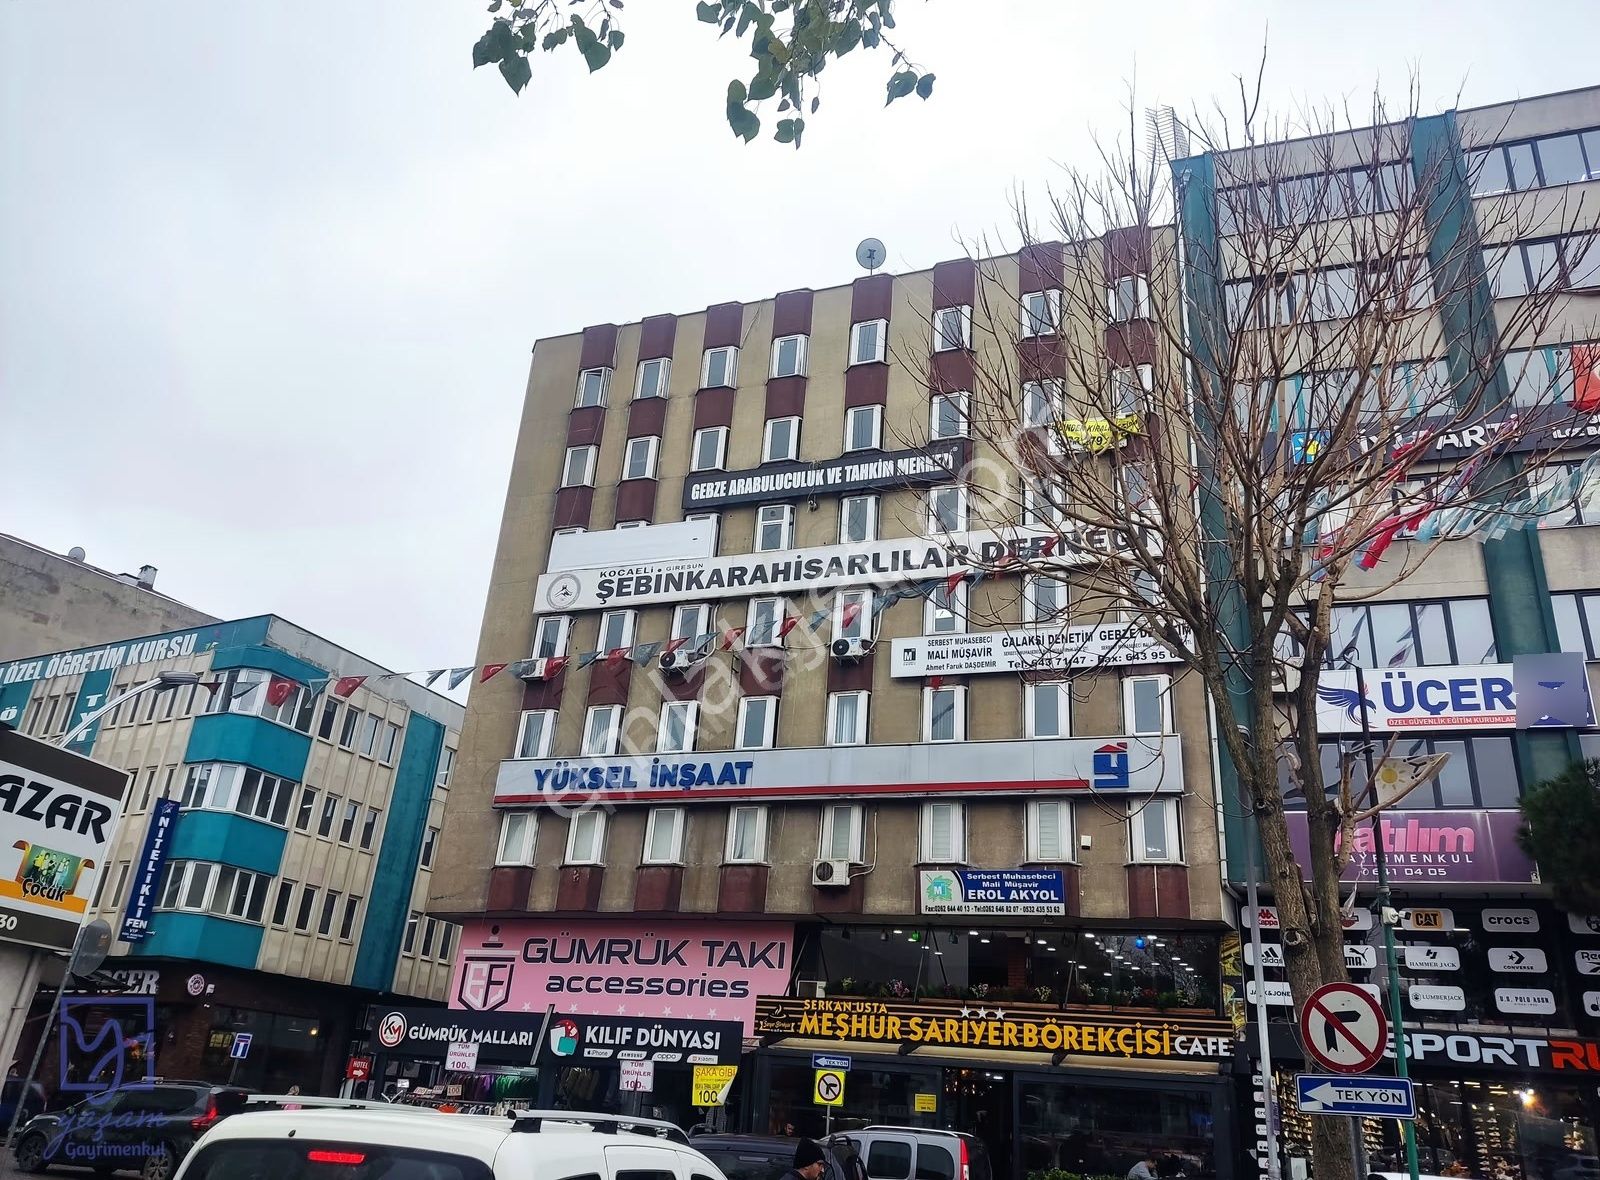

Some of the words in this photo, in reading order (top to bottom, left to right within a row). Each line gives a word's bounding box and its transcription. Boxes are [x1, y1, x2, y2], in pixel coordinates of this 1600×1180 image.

[691, 480, 728, 500] GEBZE
[728, 469, 824, 497] ARABULUCULUK
[826, 468, 843, 485] VE
[845, 458, 896, 483] TAHKİM
[927, 638, 954, 647] SERBEST
[954, 635, 993, 645] MUHASEBECİ
[1001, 632, 1045, 648] GALAKSİ
[1047, 629, 1094, 645] DENETİM
[1099, 628, 1137, 641] GEBZE
[3, 661, 42, 684] ÖZEL
[45, 643, 128, 679] ÖĞRETİM
[126, 633, 199, 666] KURSU
[927, 649, 949, 660] MALİ
[951, 646, 993, 661] MÜŞAVİR
[1072, 656, 1087, 665] 47
[1125, 652, 1147, 661] 643
[1151, 651, 1166, 660] 95
[926, 663, 945, 671] Ahmet
[946, 662, 963, 670] Faruk
[964, 660, 997, 669] DAŞDEMİR
[1381, 671, 1517, 715] ÜÇER
[1388, 718, 1408, 726] ÖZEL
[1408, 717, 1445, 726] GÜVENLİK
[1446, 716, 1473, 725] EĞİTİM
[534, 760, 637, 791] YÜKSEL
[650, 757, 753, 791] İNŞAAT
[1002, 872, 1057, 880] Muhasebeci
[1404, 867, 1424, 876] 04
[1428, 867, 1447, 876] 05
[22, 877, 66, 903] Çocuk
[1004, 880, 1039, 889] Müşavir
[967, 889, 1006, 901] EROL
[1009, 889, 1059, 901] AKYOL
[126, 917, 149, 930] FEN
[1415, 912, 1439, 927] CAT
[1488, 915, 1531, 925] crocs
[522, 931, 691, 967] GÜMRÜK
[701, 939, 786, 970] TAKI
[1262, 956, 1284, 965] didas
[546, 972, 750, 999] accessories
[803, 999, 852, 1013] SERKAN
[856, 1001, 888, 1015] USTA
[470, 1027, 534, 1047] MALLARI
[585, 1025, 633, 1046] KILIF
[636, 1024, 721, 1050] DÜNYASI
[800, 1011, 903, 1042] MEŞHUR
[1174, 1036, 1233, 1057] CAFE
[591, 1049, 609, 1057] iPhone
[352, 1060, 369, 1070] HOTEL
[825, 1059, 836, 1067] TEK
[836, 1059, 849, 1068] YÖN
[695, 1067, 717, 1079] ŞAKA
[698, 1090, 718, 1104] 100
[1335, 1089, 1366, 1101] TEK
[1367, 1089, 1403, 1104] YÖN
